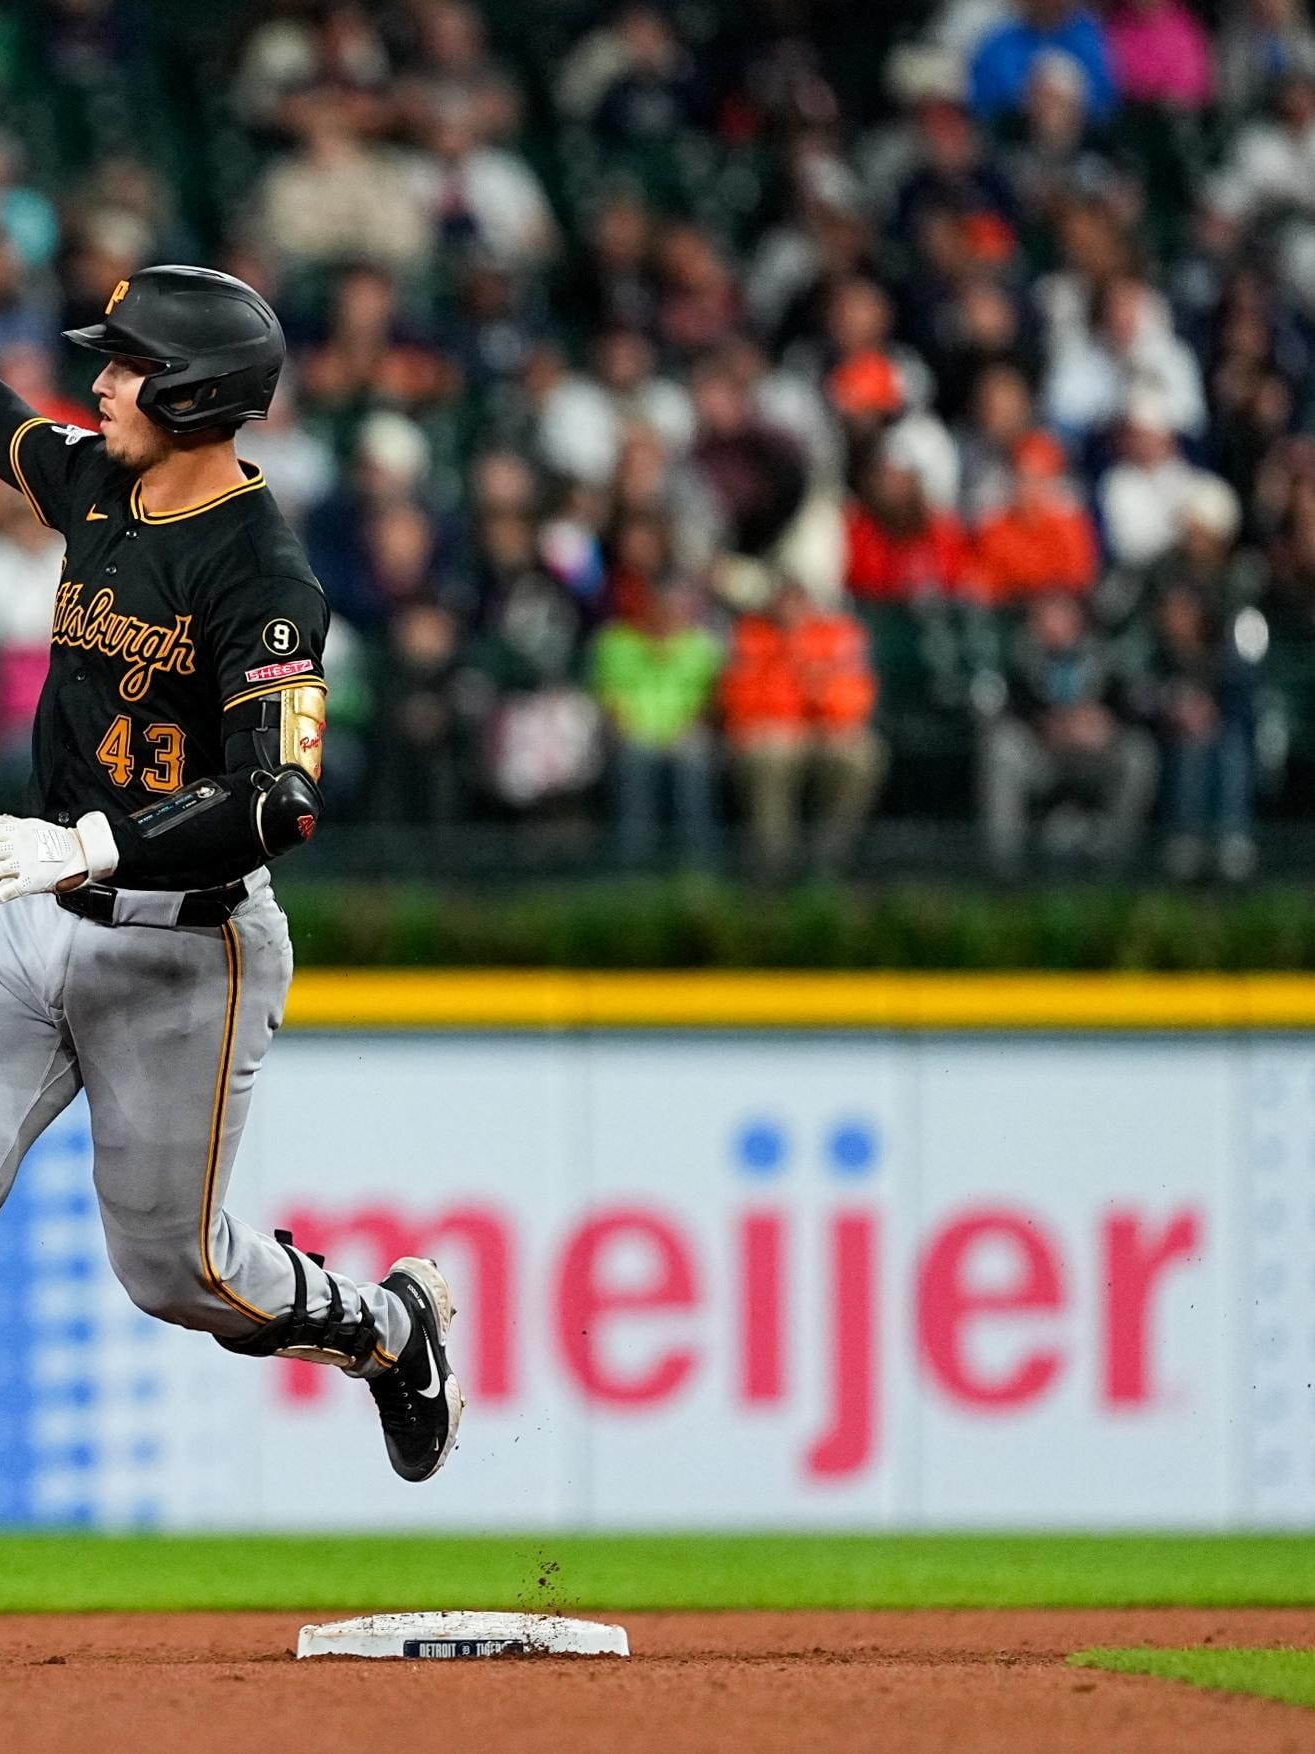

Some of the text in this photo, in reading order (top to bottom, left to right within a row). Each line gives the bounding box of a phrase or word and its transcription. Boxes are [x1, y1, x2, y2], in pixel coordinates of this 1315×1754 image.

[273, 624, 290, 650] 9
[249, 661, 311, 681] SHEETZ
[96, 714, 186, 794] 43
[275, 1113, 1204, 1482] meijer
[419, 1643, 456, 1658] DETROIT
